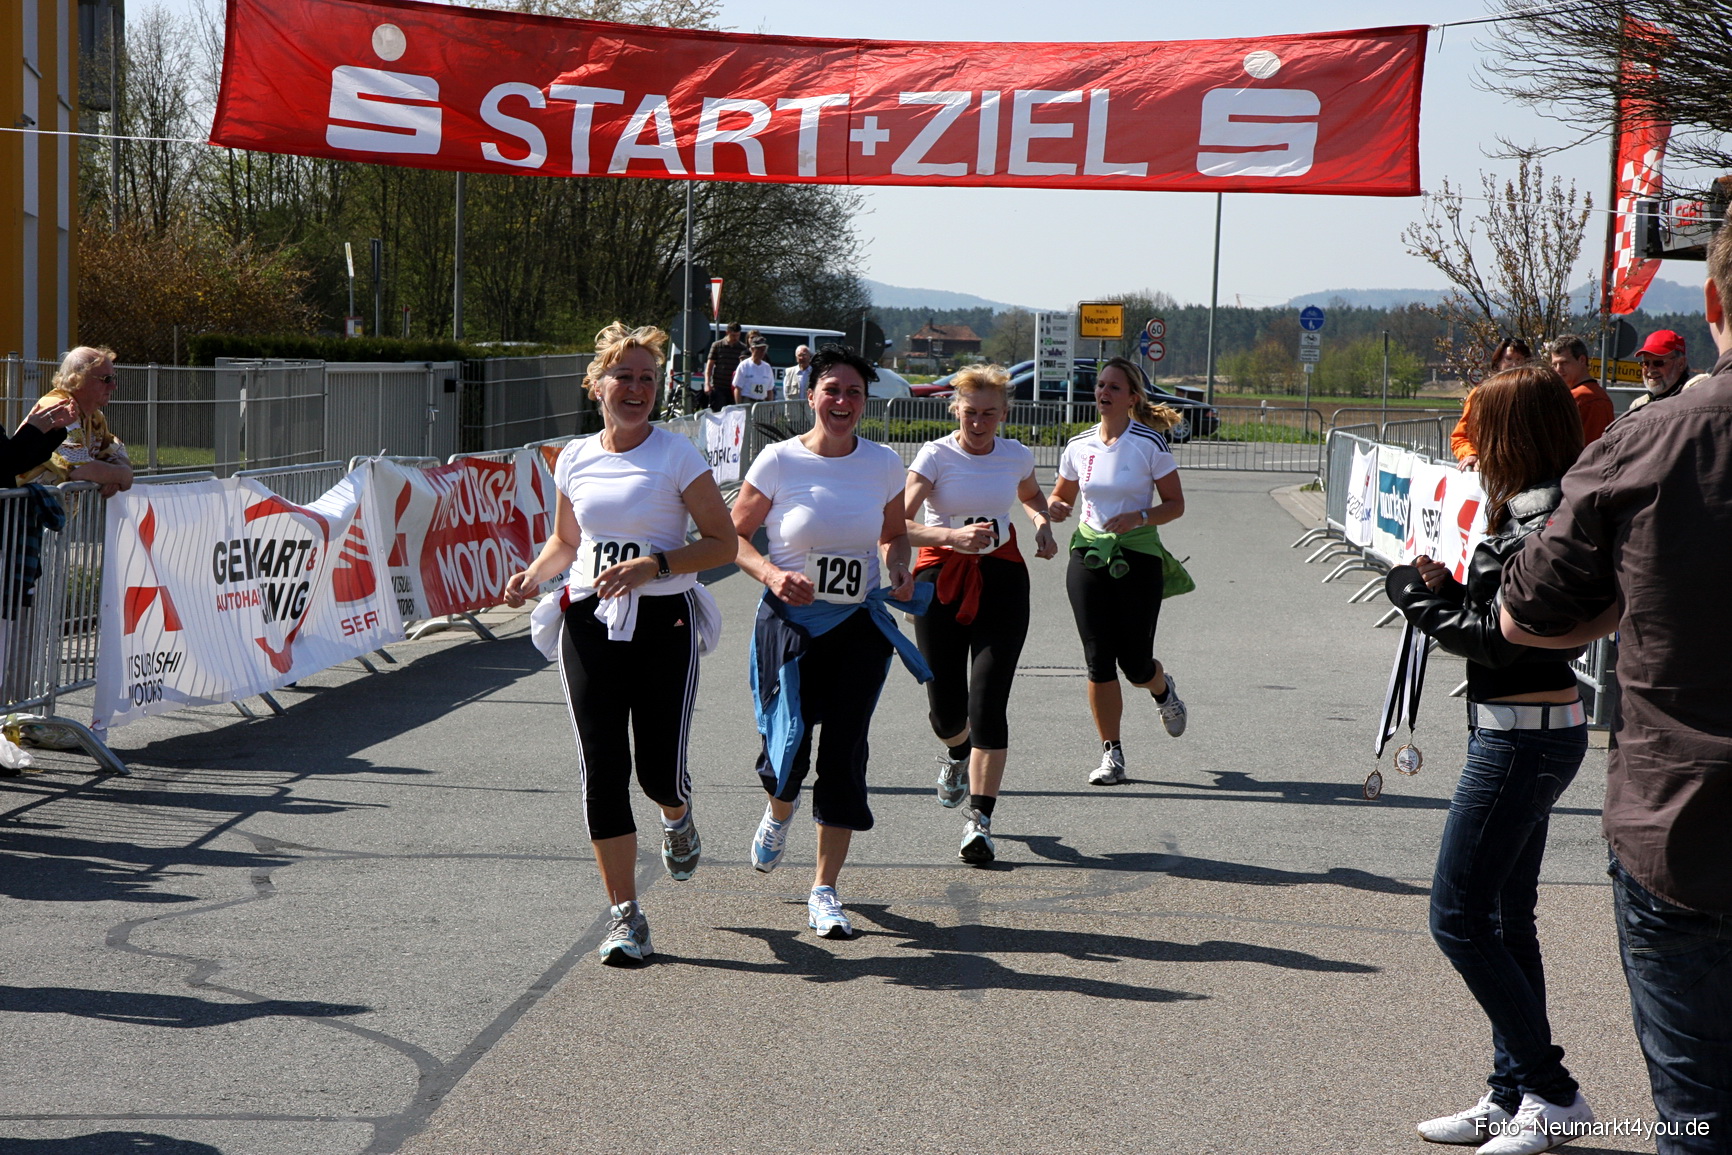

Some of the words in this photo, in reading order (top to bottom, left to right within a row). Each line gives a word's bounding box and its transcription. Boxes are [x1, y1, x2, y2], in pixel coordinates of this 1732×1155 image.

[1084, 316, 1119, 325] Neumarkt
[1151, 325, 1162, 335] 60
[754, 384, 764, 394] 43
[1085, 454, 1096, 482] team
[817, 556, 862, 597] 129
[340, 609, 380, 637] SEA
[127, 651, 182, 680] ITSUBISHI
